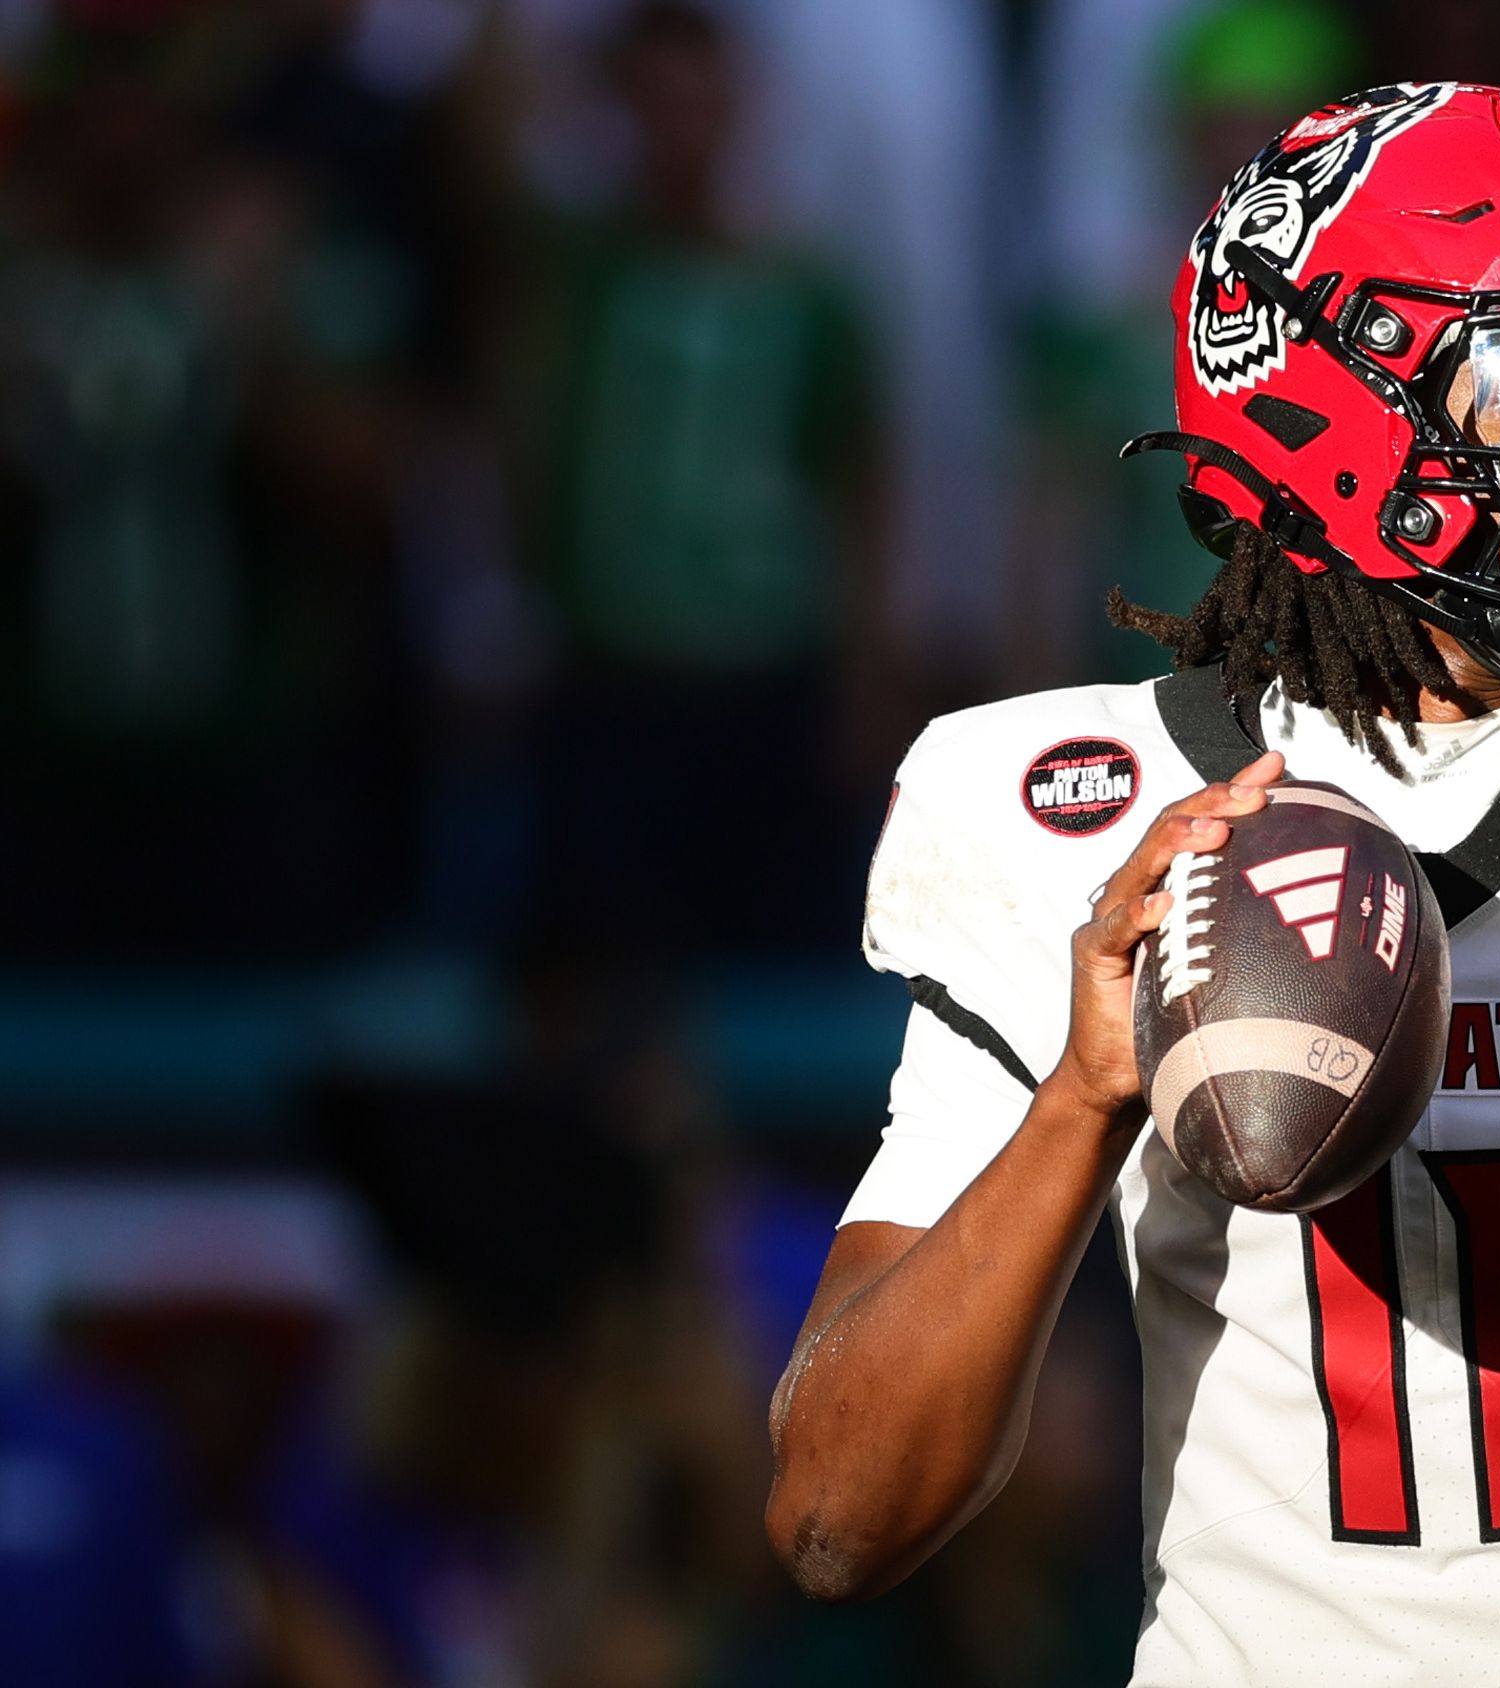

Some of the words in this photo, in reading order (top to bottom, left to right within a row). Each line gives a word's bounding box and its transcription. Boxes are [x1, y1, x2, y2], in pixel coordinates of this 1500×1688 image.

[1031, 774, 1131, 807] WILSON
[1054, 764, 1108, 783] PAYTON
[1375, 872, 1407, 974] DIME
[1307, 1037, 1359, 1082] QB
